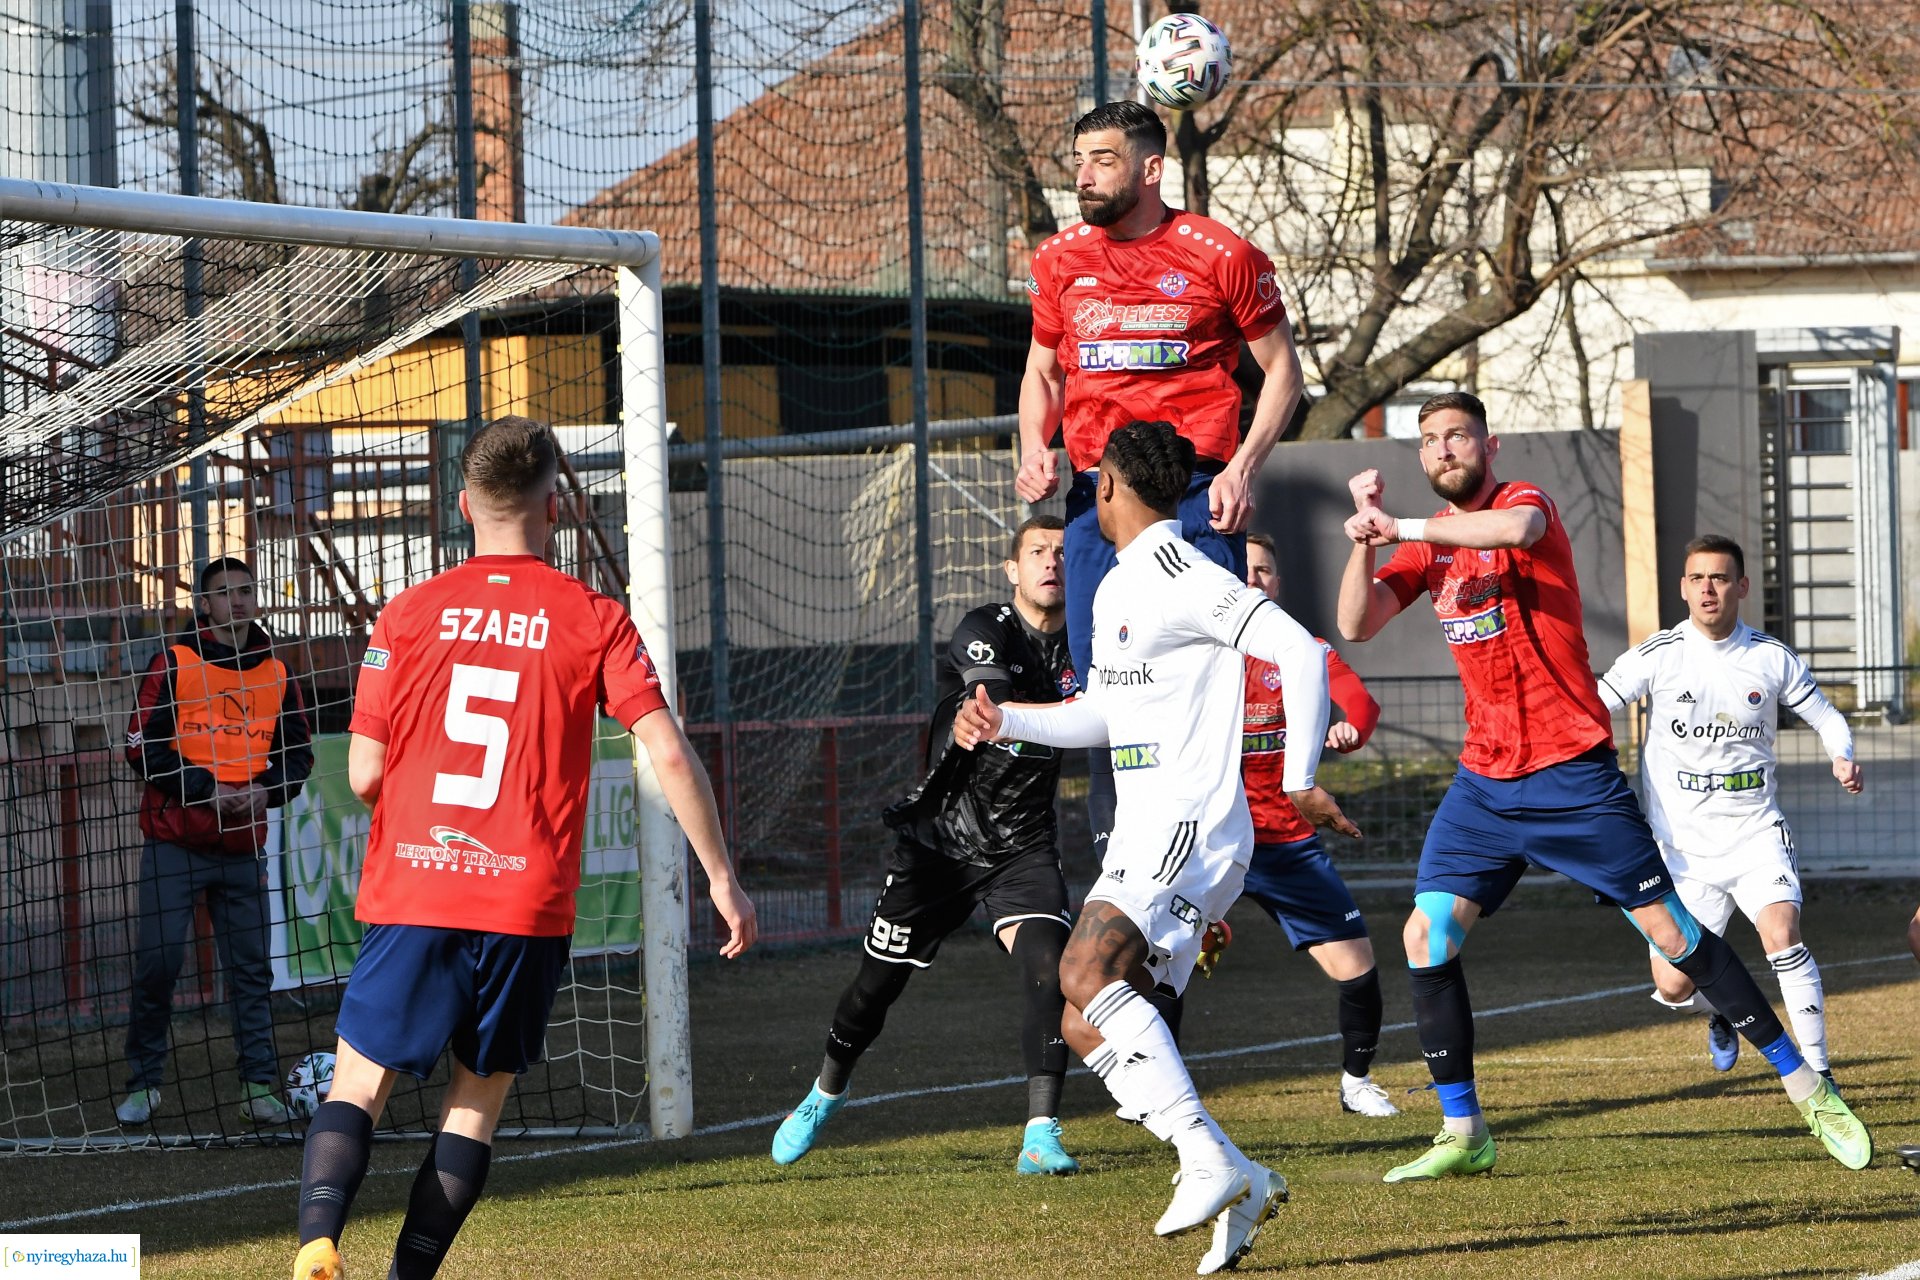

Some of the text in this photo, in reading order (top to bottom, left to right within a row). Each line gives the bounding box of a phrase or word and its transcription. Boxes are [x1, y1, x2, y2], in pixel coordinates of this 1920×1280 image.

[439, 607, 549, 650] SZABÓ
[431, 662, 520, 810] 5
[1692, 720, 1766, 743] otpbank
[593, 783, 638, 848] LIG
[395, 842, 527, 872] LERTON TRANS
[411, 859, 501, 877] HUNGARY
[1638, 875, 1661, 892] JAKO
[870, 916, 912, 954] 95
